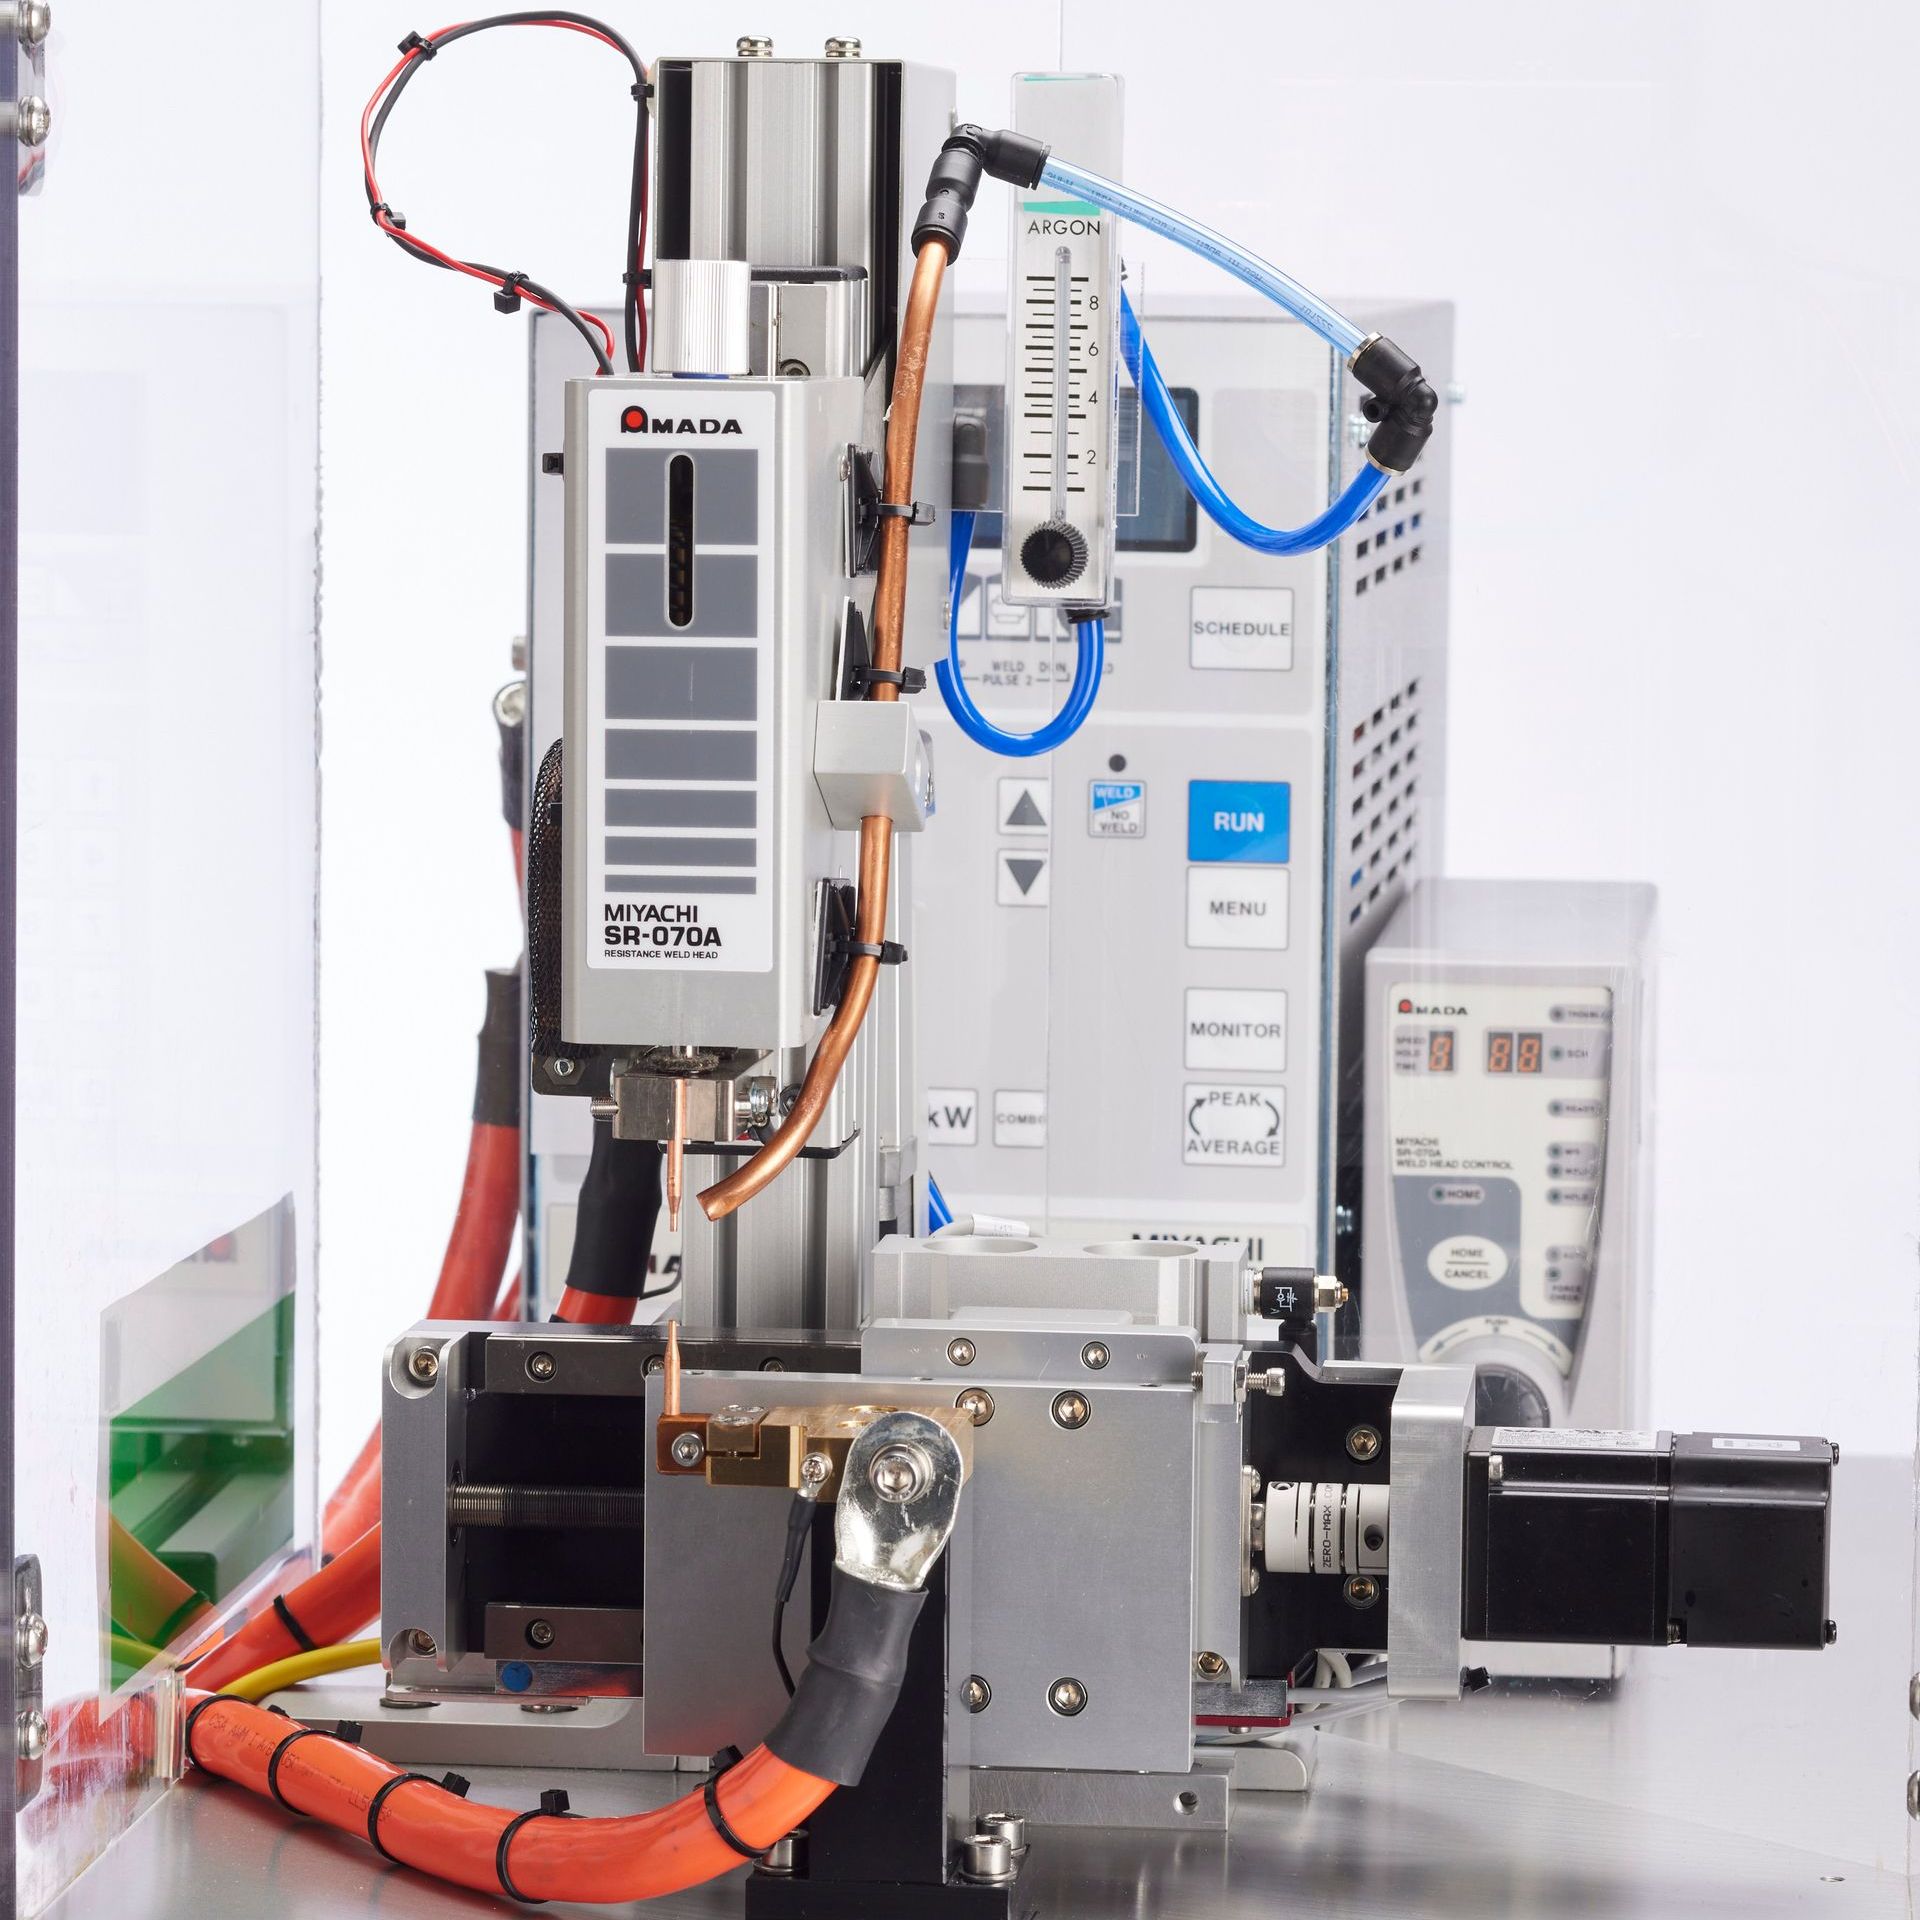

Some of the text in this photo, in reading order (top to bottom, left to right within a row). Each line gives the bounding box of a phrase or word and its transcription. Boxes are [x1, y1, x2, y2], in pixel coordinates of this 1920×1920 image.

[1027, 219, 1101, 236] ARGON
[1089, 295, 1099, 310] 8
[1088, 341, 1099, 356] 6
[1087, 390, 1098, 405] 4
[620, 405, 743, 435] AMADA
[1086, 449, 1097, 465] 2
[1193, 621, 1290, 636] SCHEDULE
[982, 674, 1019, 686] PULSE
[1095, 787, 1134, 799] WELD
[1110, 811, 1130, 820] NO
[1213, 811, 1265, 832] RUN
[1100, 822, 1138, 833] WELD
[604, 903, 698, 923] MIYACHI
[1209, 900, 1267, 916] MENU
[604, 925, 722, 947] SR-070A
[604, 949, 719, 960] RESISTANCE WELD HEAD
[1189, 1021, 1281, 1039] MONITOR
[1209, 1090, 1262, 1107] PEAK
[1186, 1140, 1281, 1156] AVERAGE
[1430, 1159, 1458, 1168] HEAD
[1461, 1160, 1514, 1170] CONTROL
[1447, 1189, 1481, 1199] HOME
[1451, 1249, 1484, 1258] HOME
[1445, 1269, 1490, 1280] CANCEL
